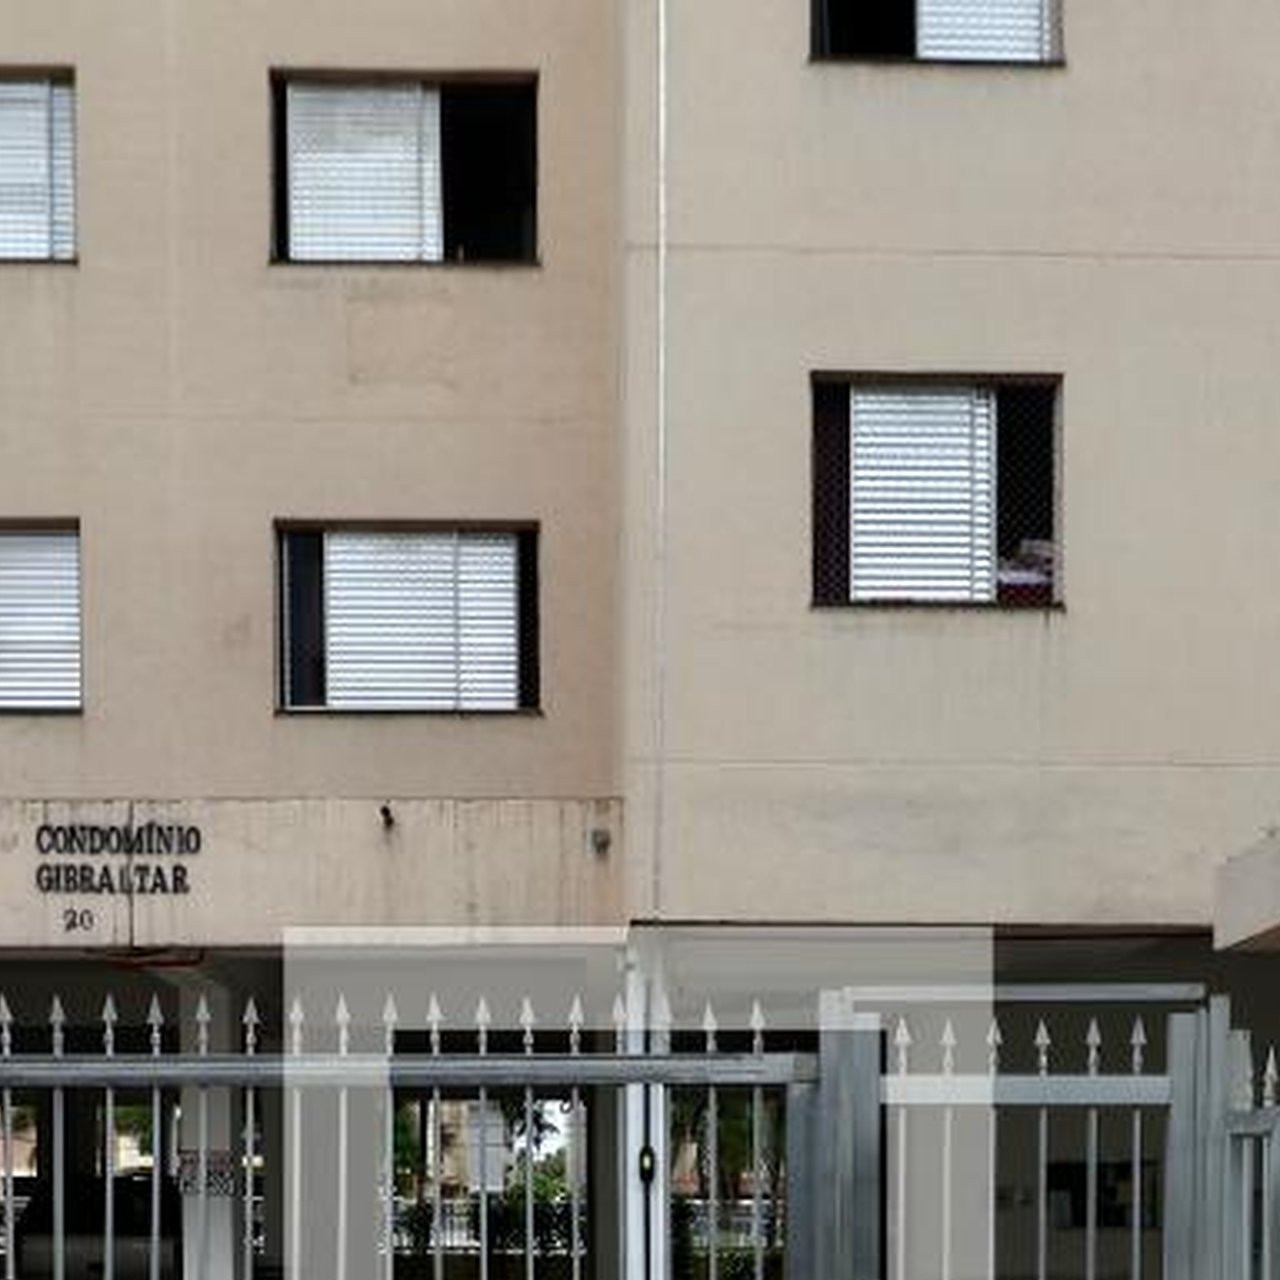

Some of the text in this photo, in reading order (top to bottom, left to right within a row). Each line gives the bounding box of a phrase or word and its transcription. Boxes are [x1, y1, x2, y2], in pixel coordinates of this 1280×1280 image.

[36, 820, 201, 854] CONDOMÍNIO
[36, 864, 191, 893] GIBRALTAR
[63, 909, 94, 932] 20
